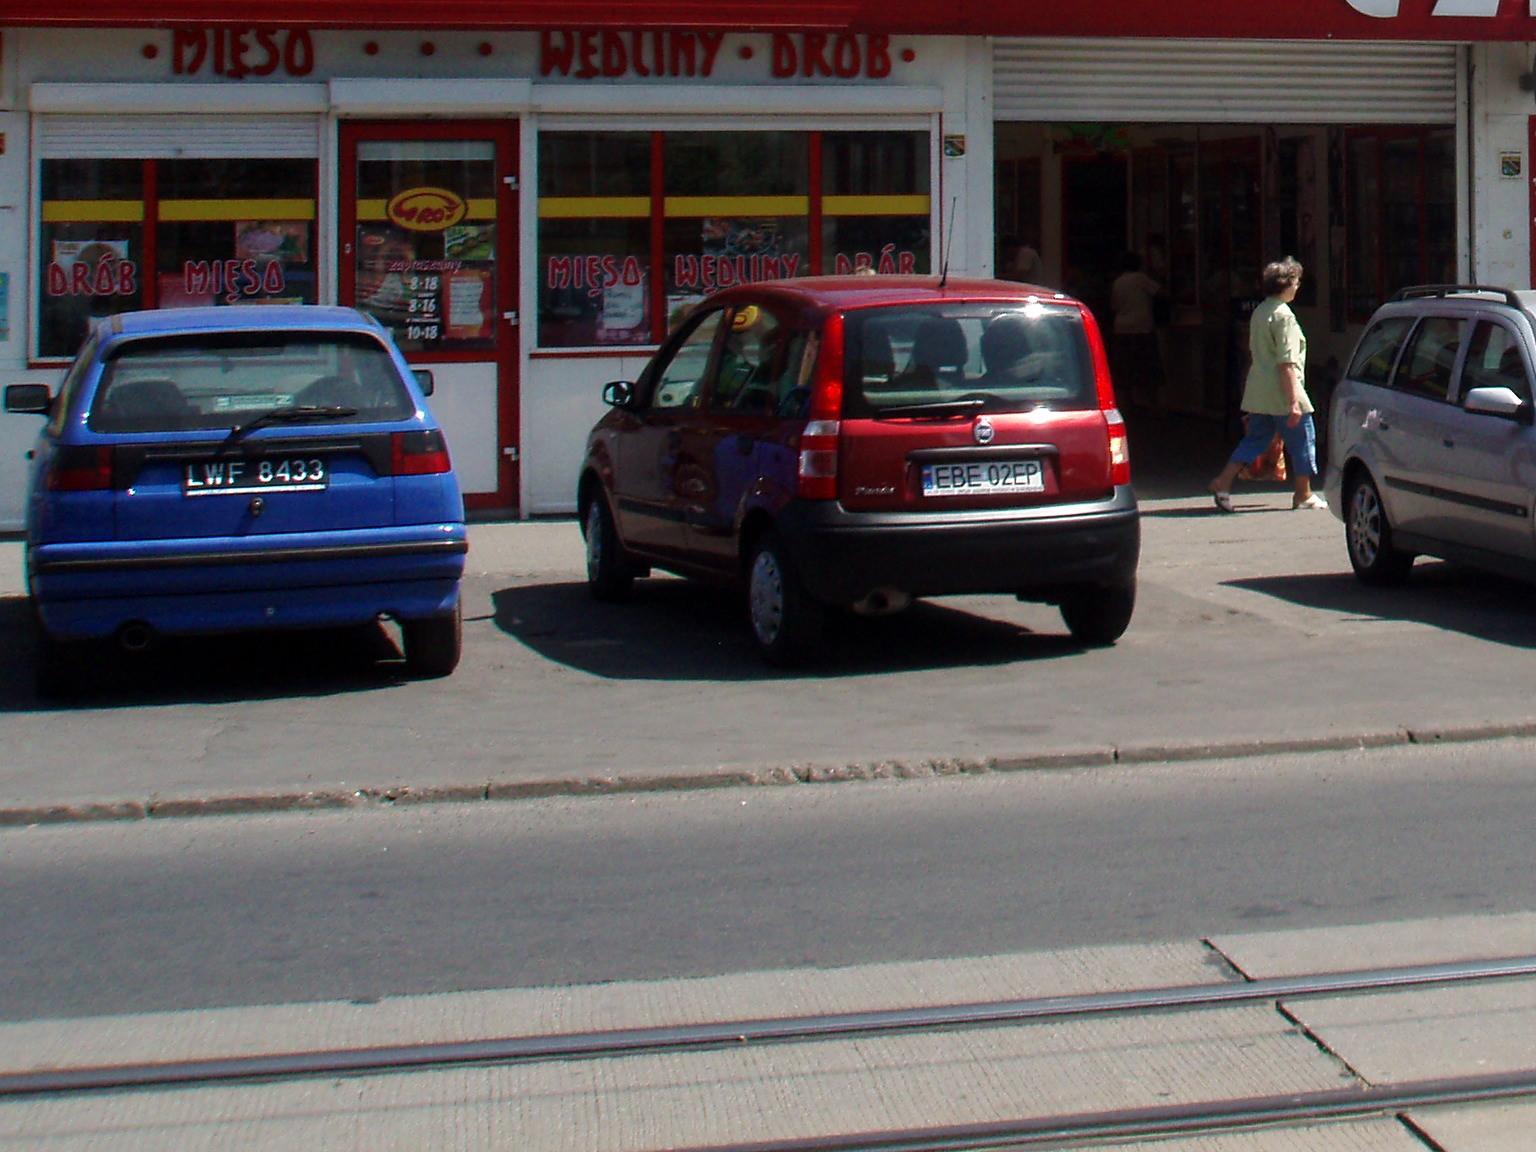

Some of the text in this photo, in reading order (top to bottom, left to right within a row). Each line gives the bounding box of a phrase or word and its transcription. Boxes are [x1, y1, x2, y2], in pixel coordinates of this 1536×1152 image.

[47, 254, 137, 296] DRÓB
[187, 459, 324, 488] LWF 8433
[936, 463, 1039, 489] EBE 02EP
